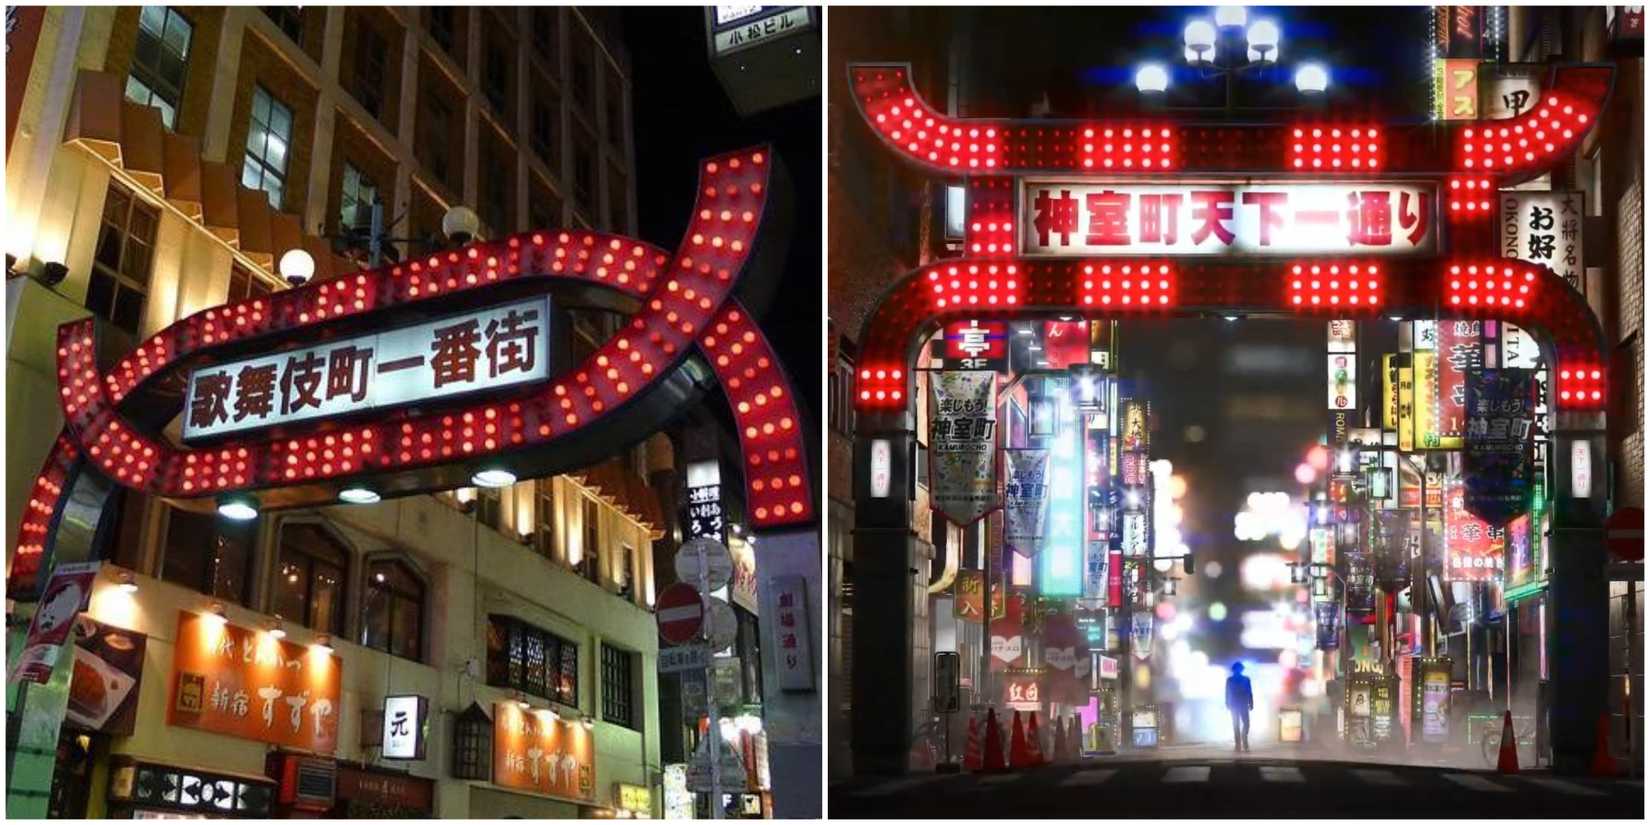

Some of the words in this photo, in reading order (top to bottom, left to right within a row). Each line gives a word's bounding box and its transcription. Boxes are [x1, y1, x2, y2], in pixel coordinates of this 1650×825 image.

[1033, 189, 1429, 247] 神室町天下一通り
[1528, 205, 1556, 260] お好
[958, 320, 990, 357] 亭
[189, 309, 539, 428] 歌舞伎町一番街
[931, 418, 996, 441] 神室町
[390, 711, 409, 737] 元
